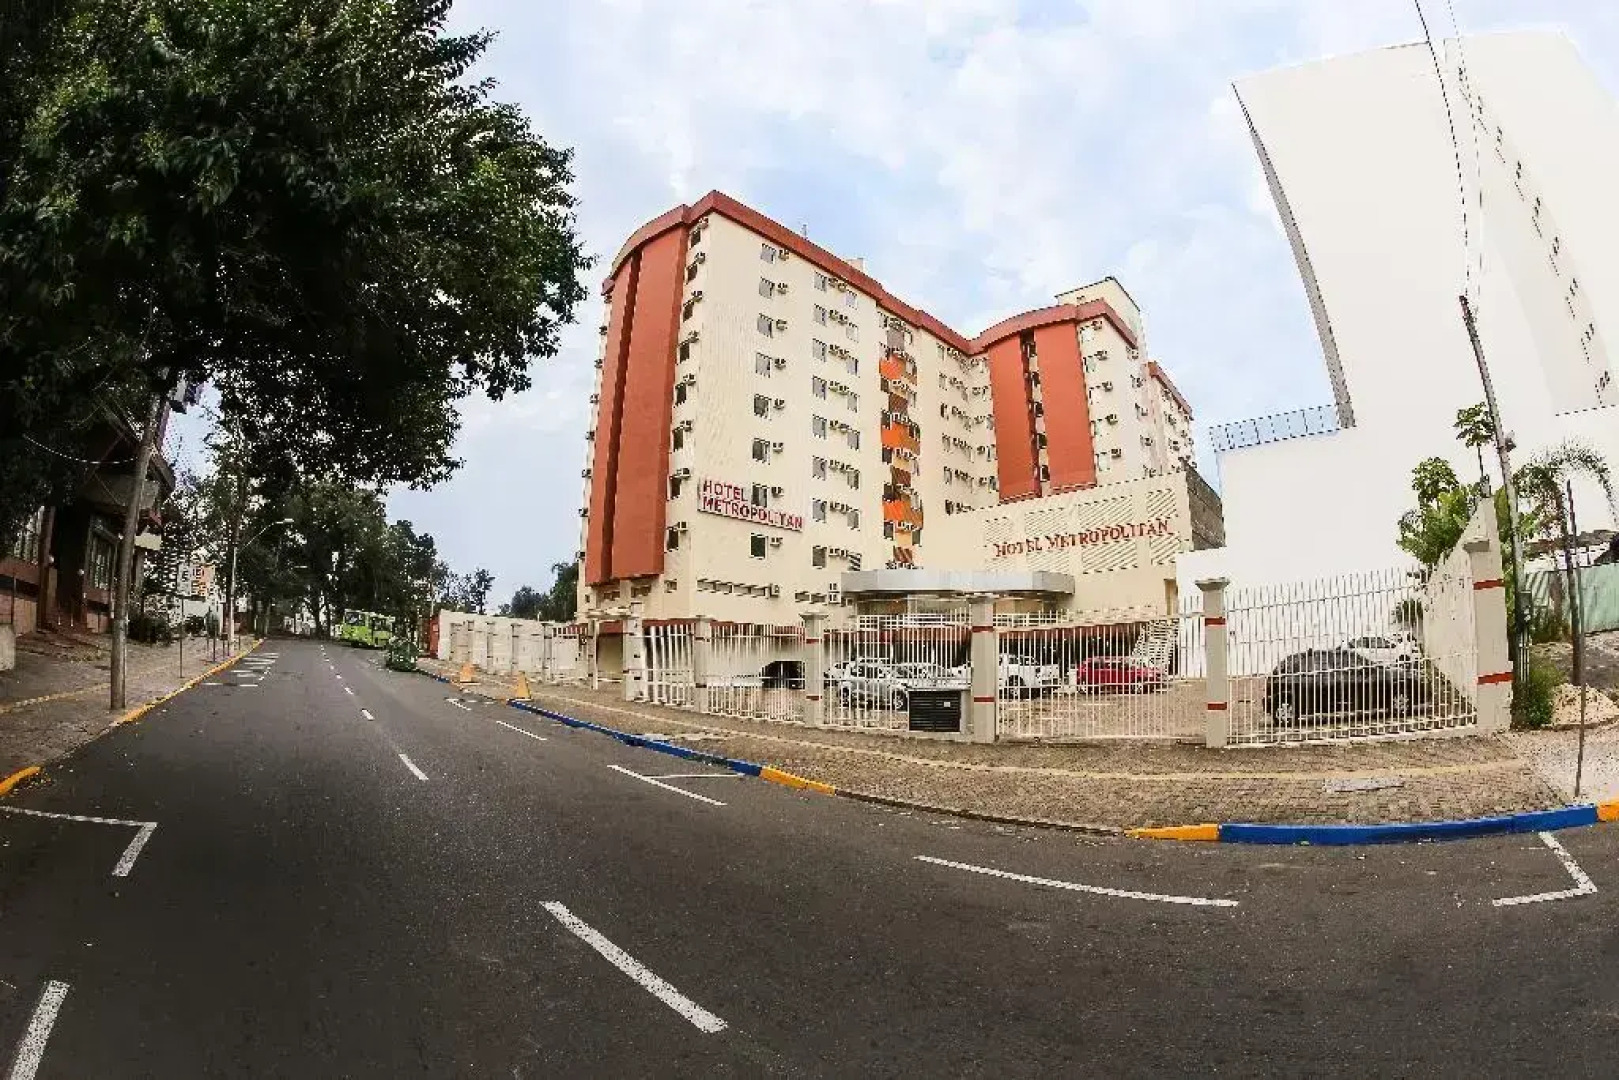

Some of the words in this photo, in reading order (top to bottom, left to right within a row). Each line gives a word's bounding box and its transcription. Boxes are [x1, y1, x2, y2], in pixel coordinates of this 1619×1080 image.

[702, 479, 748, 502] HOTEL
[702, 496, 803, 529] METROPOLITAN
[994, 537, 1042, 557] HOTEL
[1046, 520, 1168, 549] METROPOLITAN
